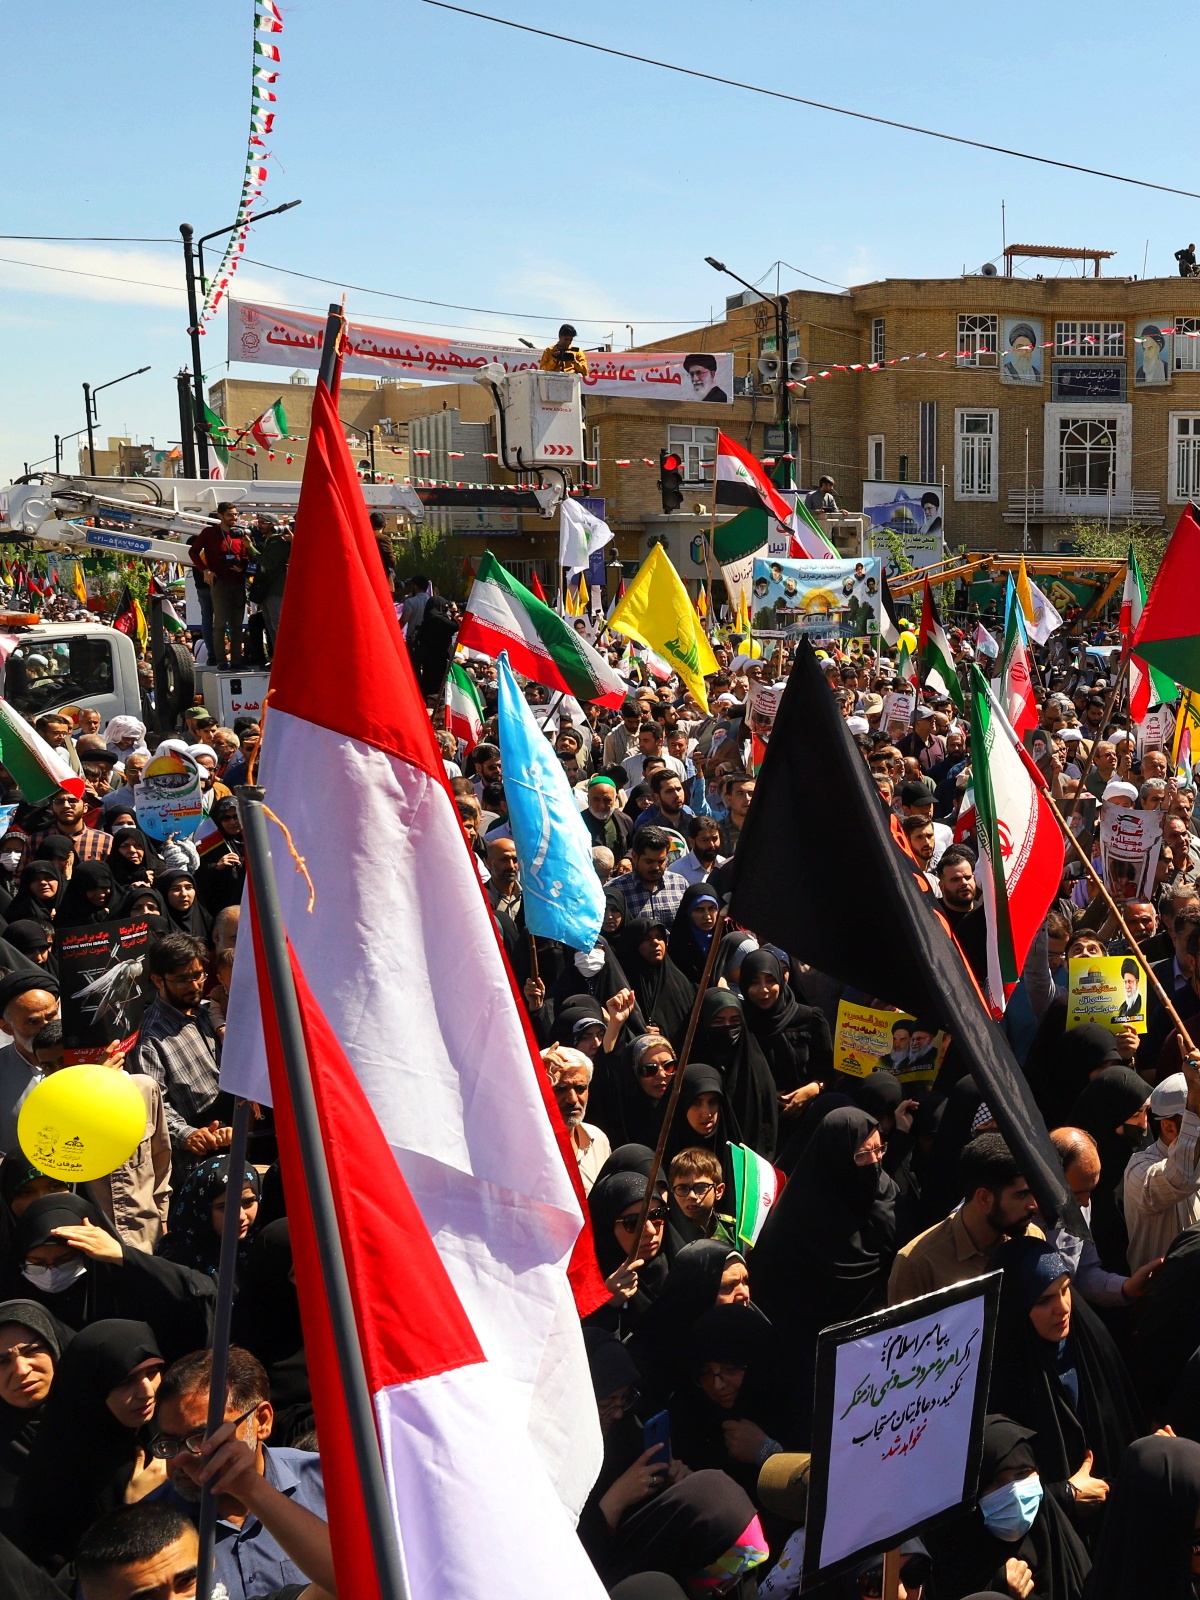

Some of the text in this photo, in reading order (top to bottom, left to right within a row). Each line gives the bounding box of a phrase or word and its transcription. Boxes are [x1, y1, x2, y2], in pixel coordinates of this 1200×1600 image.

[266, 326, 324, 350] است
[582, 361, 637, 386] عاشق
[231, 700, 260, 716] همه جا
[158, 800, 202, 818] فلسطین
[1110, 835, 1143, 847] مظلوم
[1112, 821, 1144, 839] غزه
[62, 932, 110, 946] مرگ بر اسرائیل
[57, 1160, 83, 1168] طوفان
[886, 1323, 950, 1371] پیامبر اسلام
[956, 1328, 980, 1367] اگر
[897, 1357, 942, 1390] معروف
[934, 1347, 959, 1383] امر
[840, 1373, 870, 1421] منکر
[852, 1410, 897, 1447] مستجاب
[898, 1418, 928, 1457] نخواهد
